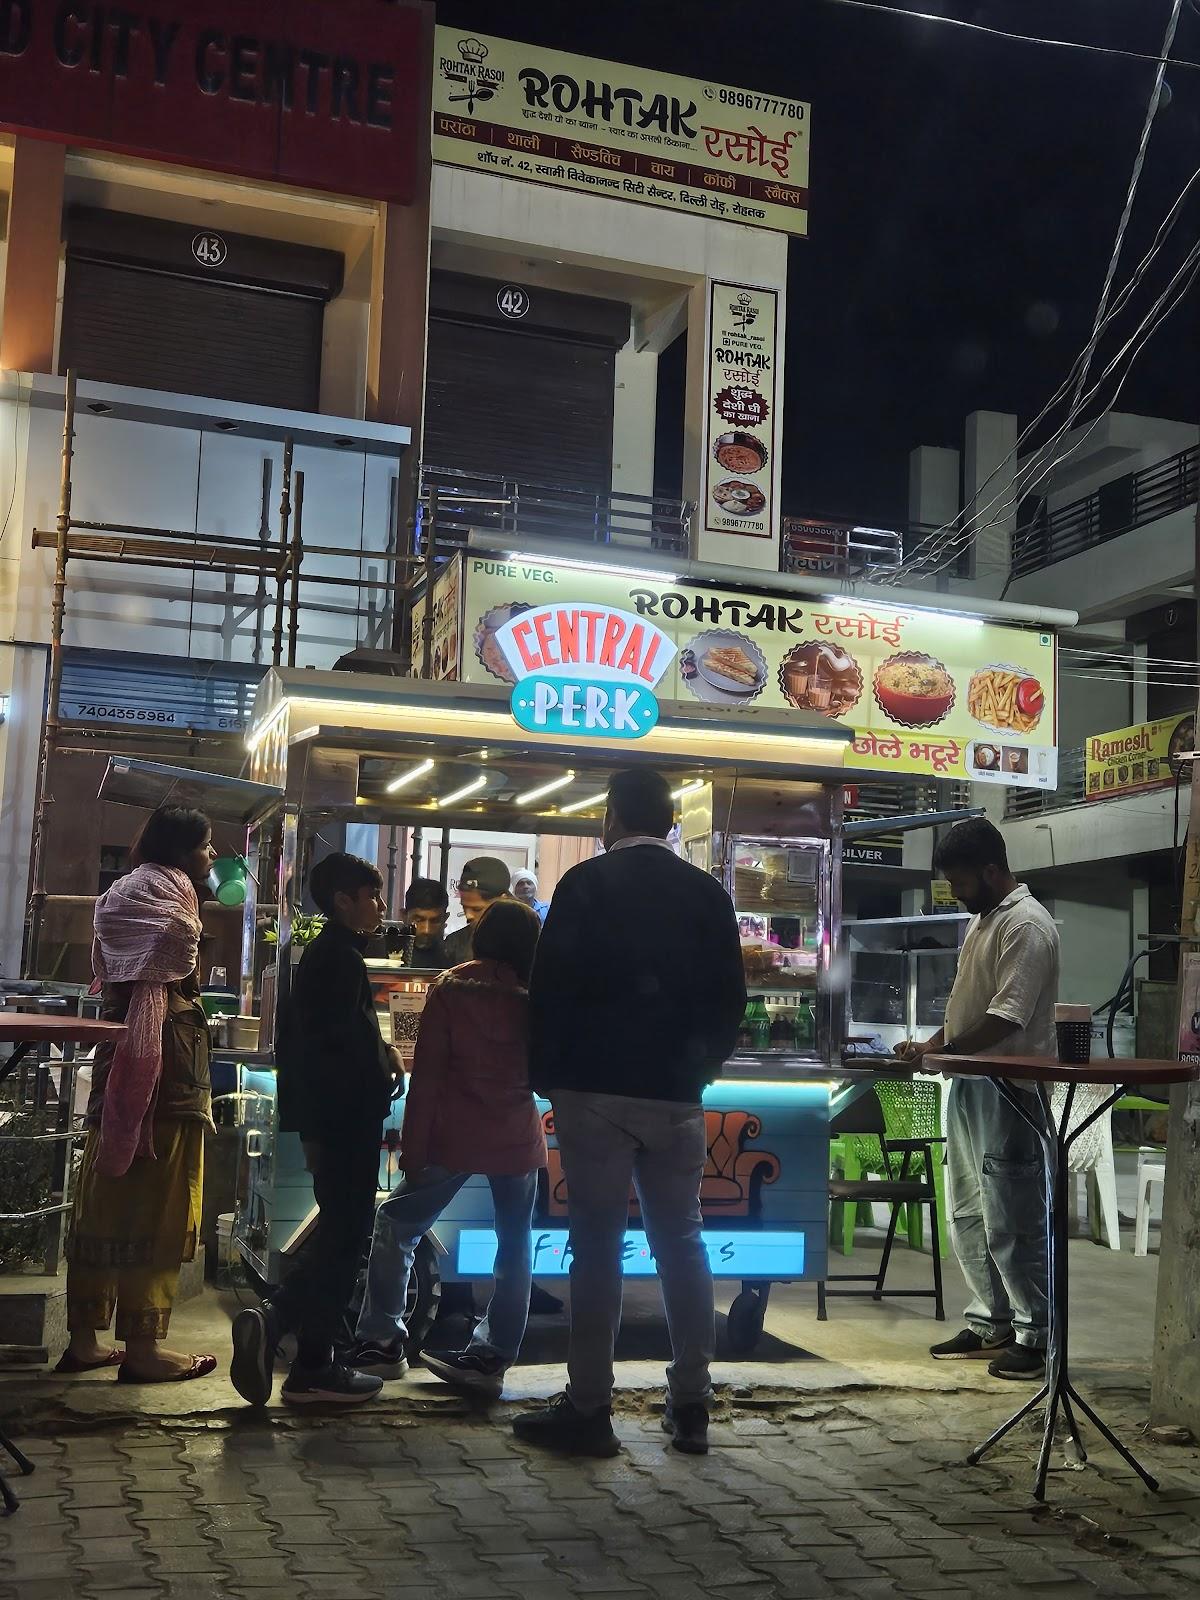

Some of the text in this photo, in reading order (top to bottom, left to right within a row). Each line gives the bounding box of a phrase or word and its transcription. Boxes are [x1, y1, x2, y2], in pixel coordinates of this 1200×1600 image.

[53, 3, 182, 87] CITY
[196, 28, 395, 132] CENTRE
[440, 57, 504, 82] ROHTAK RASOI
[518, 67, 698, 139] ROHTAK
[719, 88, 804, 120] 9896777780
[507, 131, 542, 151] थाली
[701, 125, 798, 179] रसोई
[477, 150, 498, 165] शॉप
[535, 162, 565, 180] स्वामी
[623, 179, 645, 195] सिटी
[679, 191, 708, 208] दिल्ली
[732, 202, 767, 219] रोहतक
[196, 236, 220, 262] 43
[501, 289, 523, 314] 42
[715, 347, 771, 370] ROHTAK
[732, 340, 748, 348] PURE
[723, 368, 763, 388] रसोई
[723, 410, 736, 419] का
[473, 561, 559, 584] PURE VEG.
[629, 587, 804, 634] ROHTAK
[811, 612, 909, 648] रसोई
[511, 609, 662, 683] CENTRAL
[77, 704, 176, 724] 7404355984
[852, 731, 961, 772] छोले भटूरे
[1091, 727, 1153, 762] Ramesh
